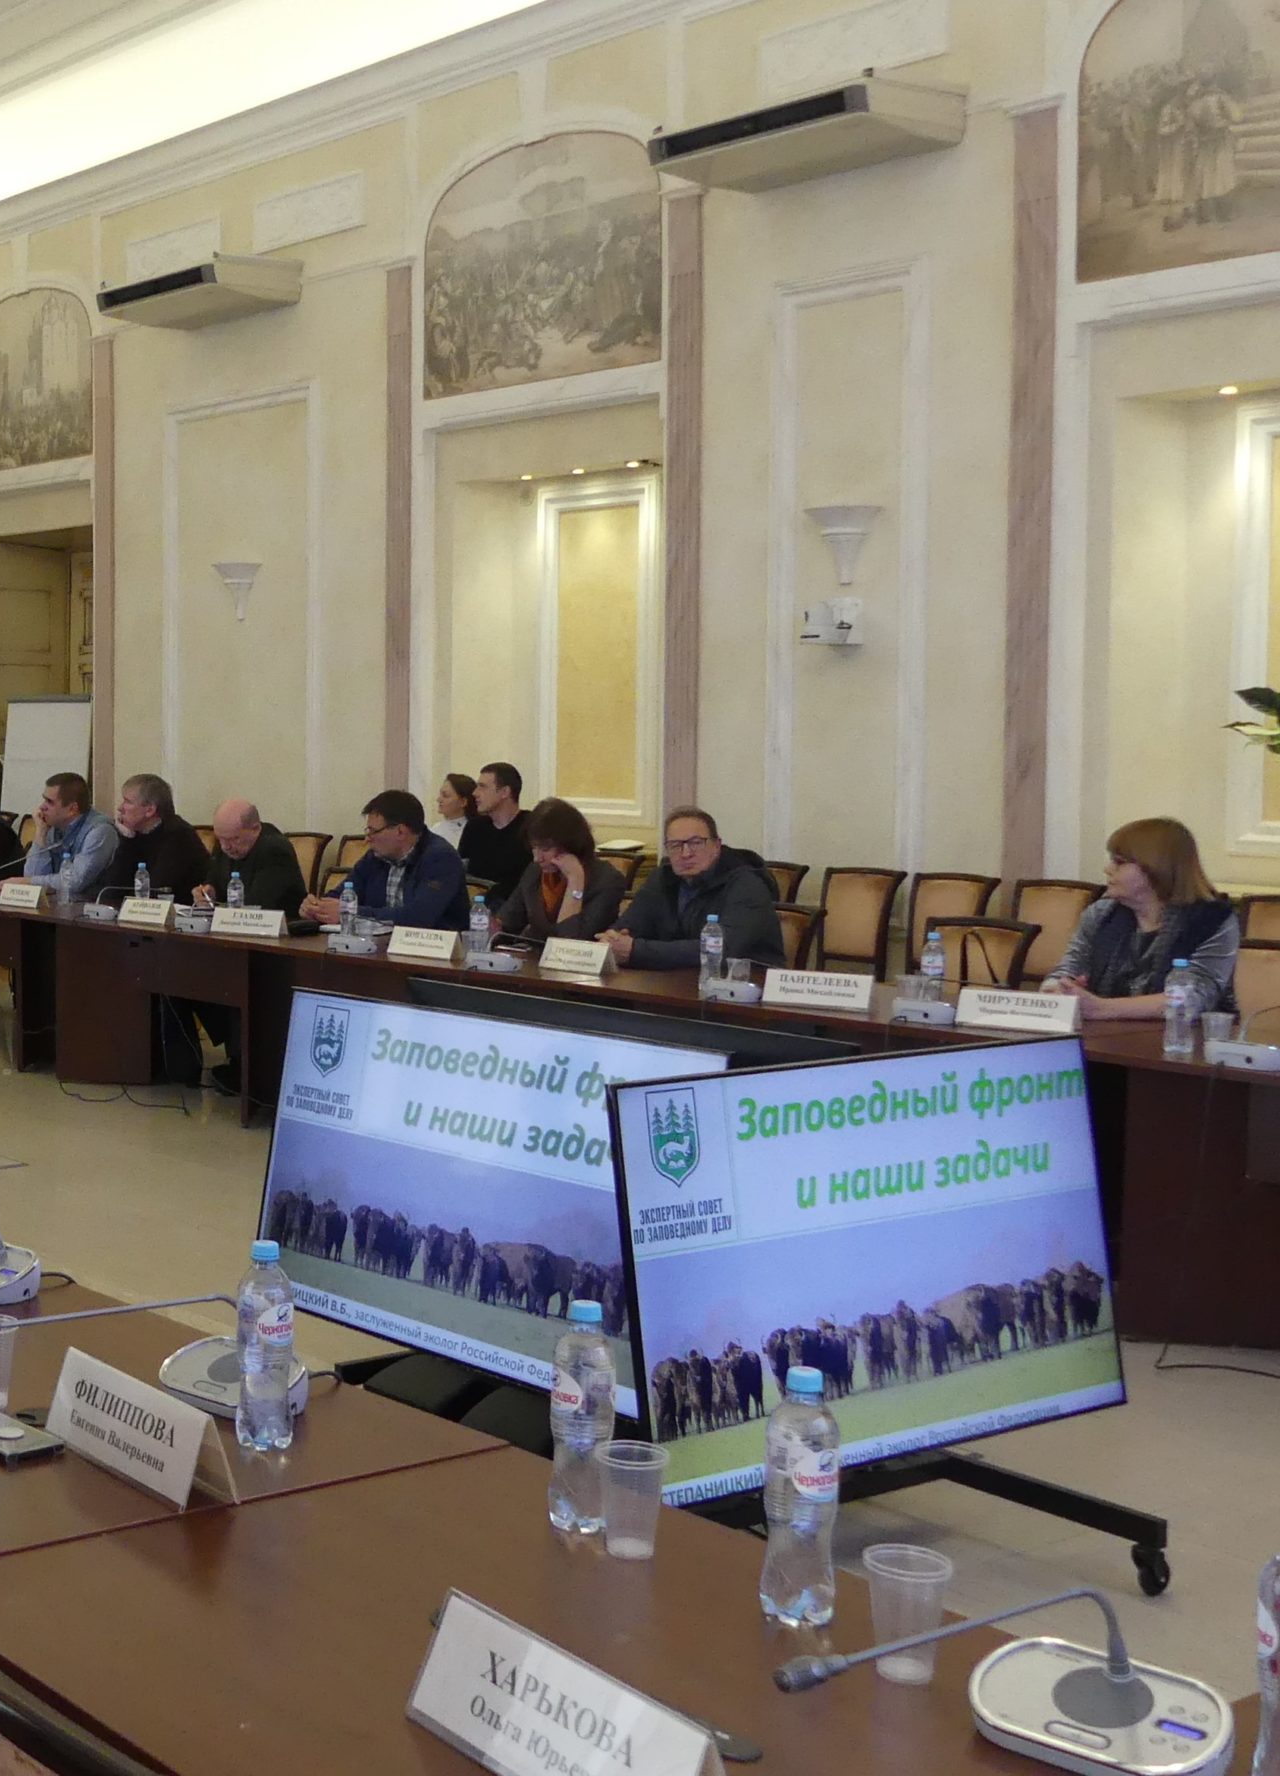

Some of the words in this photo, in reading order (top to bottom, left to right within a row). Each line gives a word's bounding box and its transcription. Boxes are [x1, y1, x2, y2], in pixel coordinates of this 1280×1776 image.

[780, 974, 859, 988] ПАНТЕЛЕЕВА
[977, 993, 1059, 1009] МИРУТЕНКО
[371, 1028, 569, 1095] Заповедный
[403, 1100, 423, 1128] и
[428, 1105, 518, 1148] наши
[523, 1123, 613, 1168] зада
[736, 1069, 960, 1142] Заповедный
[968, 1067, 1085, 1120] фронт
[796, 1175, 817, 1209] и
[828, 1159, 926, 1205] наши
[934, 1140, 1050, 1189] задачи
[633, 1228, 645, 1245] ПО
[647, 1218, 708, 1243] ЗАПОВЕДНОМУ
[711, 1215, 732, 1235] ДЕЛУ
[639, 1200, 696, 1225] ЭКСПЕРТНЫЙ
[697, 1198, 723, 1216] СОВЕТ
[354, 1309, 421, 1338] заслуженный
[423, 1331, 459, 1351] эколог
[461, 1341, 525, 1373] Российской
[70, 1408, 107, 1442] Евгения
[107, 1429, 165, 1473] Валерьевна
[74, 1376, 176, 1448] ФИЛИППОВА
[661, 1465, 764, 1506] СТЕПАНИЦКИЙ
[469, 1694, 522, 1743] Ольга
[480, 1650, 633, 1769] ХАРЬКОВА
